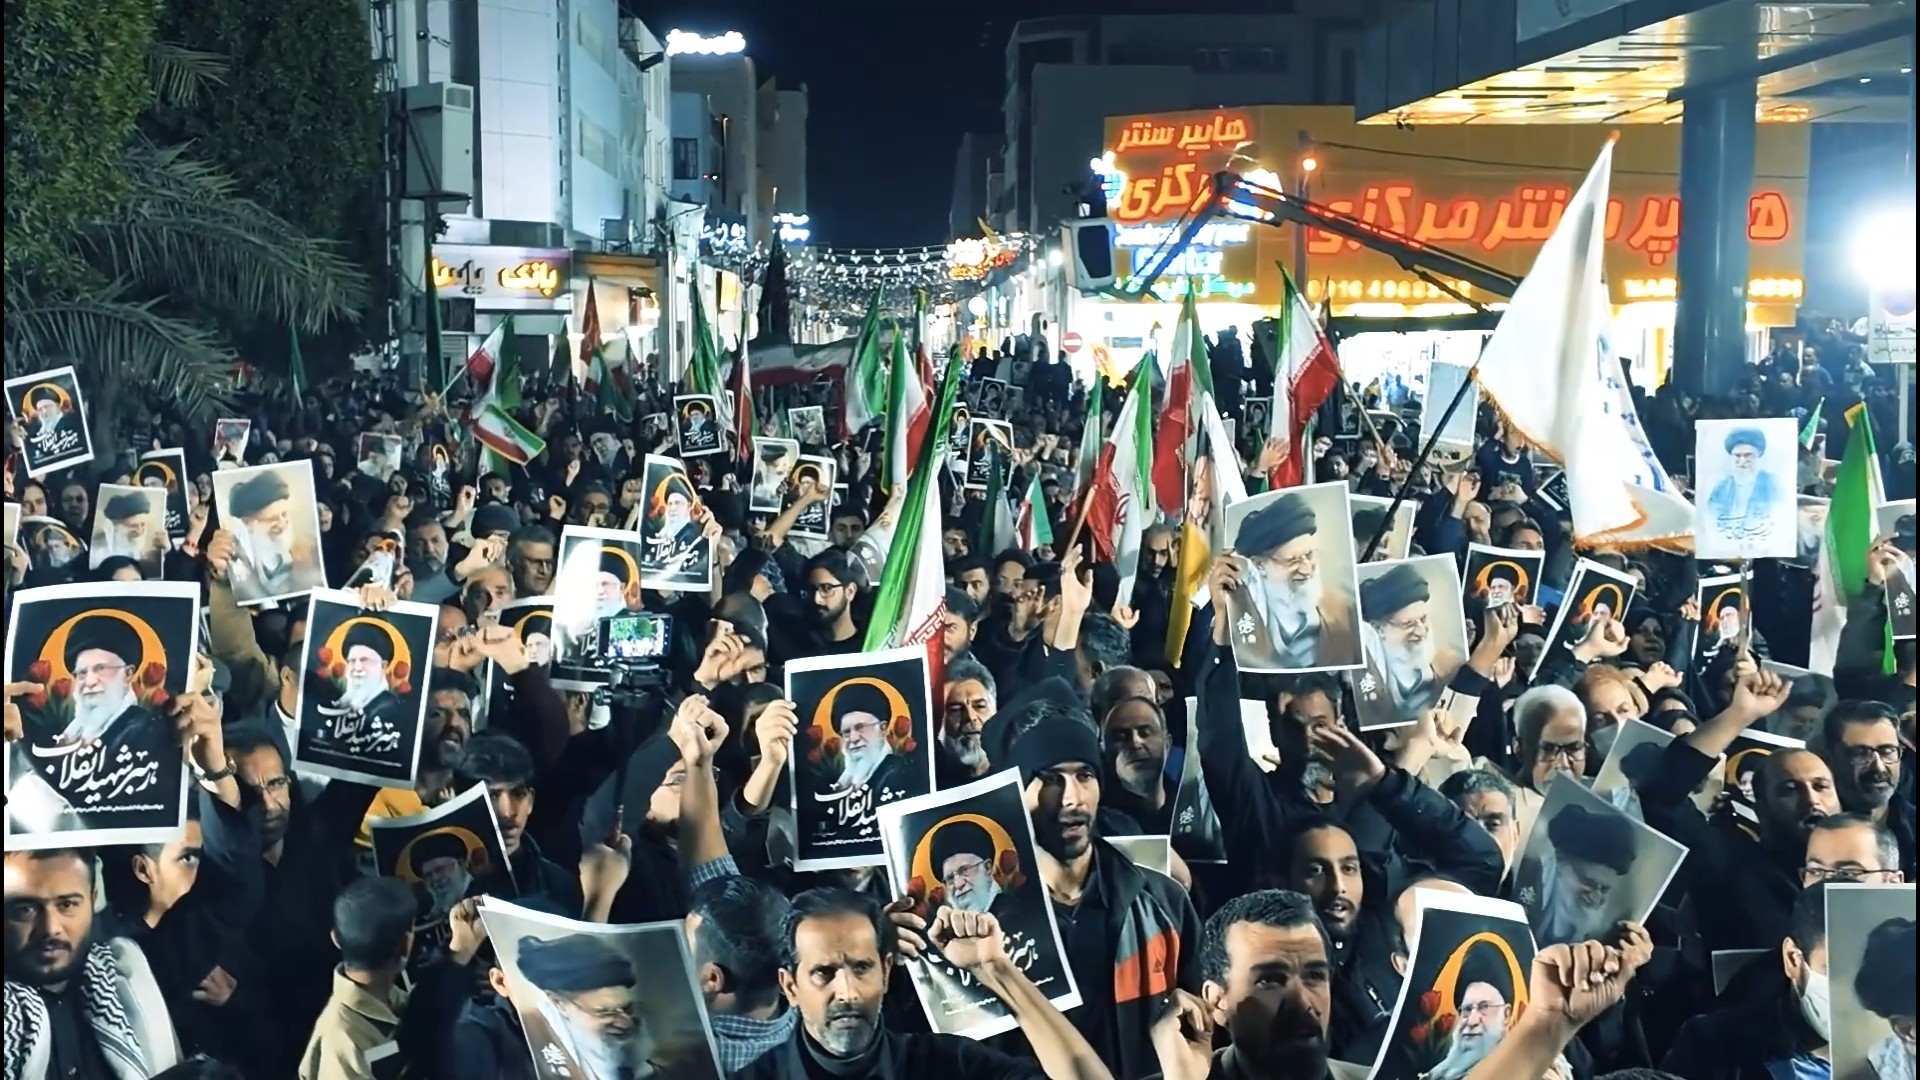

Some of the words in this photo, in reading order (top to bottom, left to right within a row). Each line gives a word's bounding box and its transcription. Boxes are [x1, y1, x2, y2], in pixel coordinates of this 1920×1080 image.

[1116, 121, 1175, 152] سنتر
[1177, 115, 1247, 156] هایپر
[1118, 163, 1211, 220] رکزی
[498, 259, 557, 296] بانک
[316, 699, 367, 739] انقلاب
[344, 715, 384, 754] شهید
[364, 721, 401, 753] رهبر
[32, 733, 107, 790] انقلاب
[74, 743, 134, 804] شهید
[106, 749, 160, 799] رهبر
[813, 782, 874, 826] انقلاب
